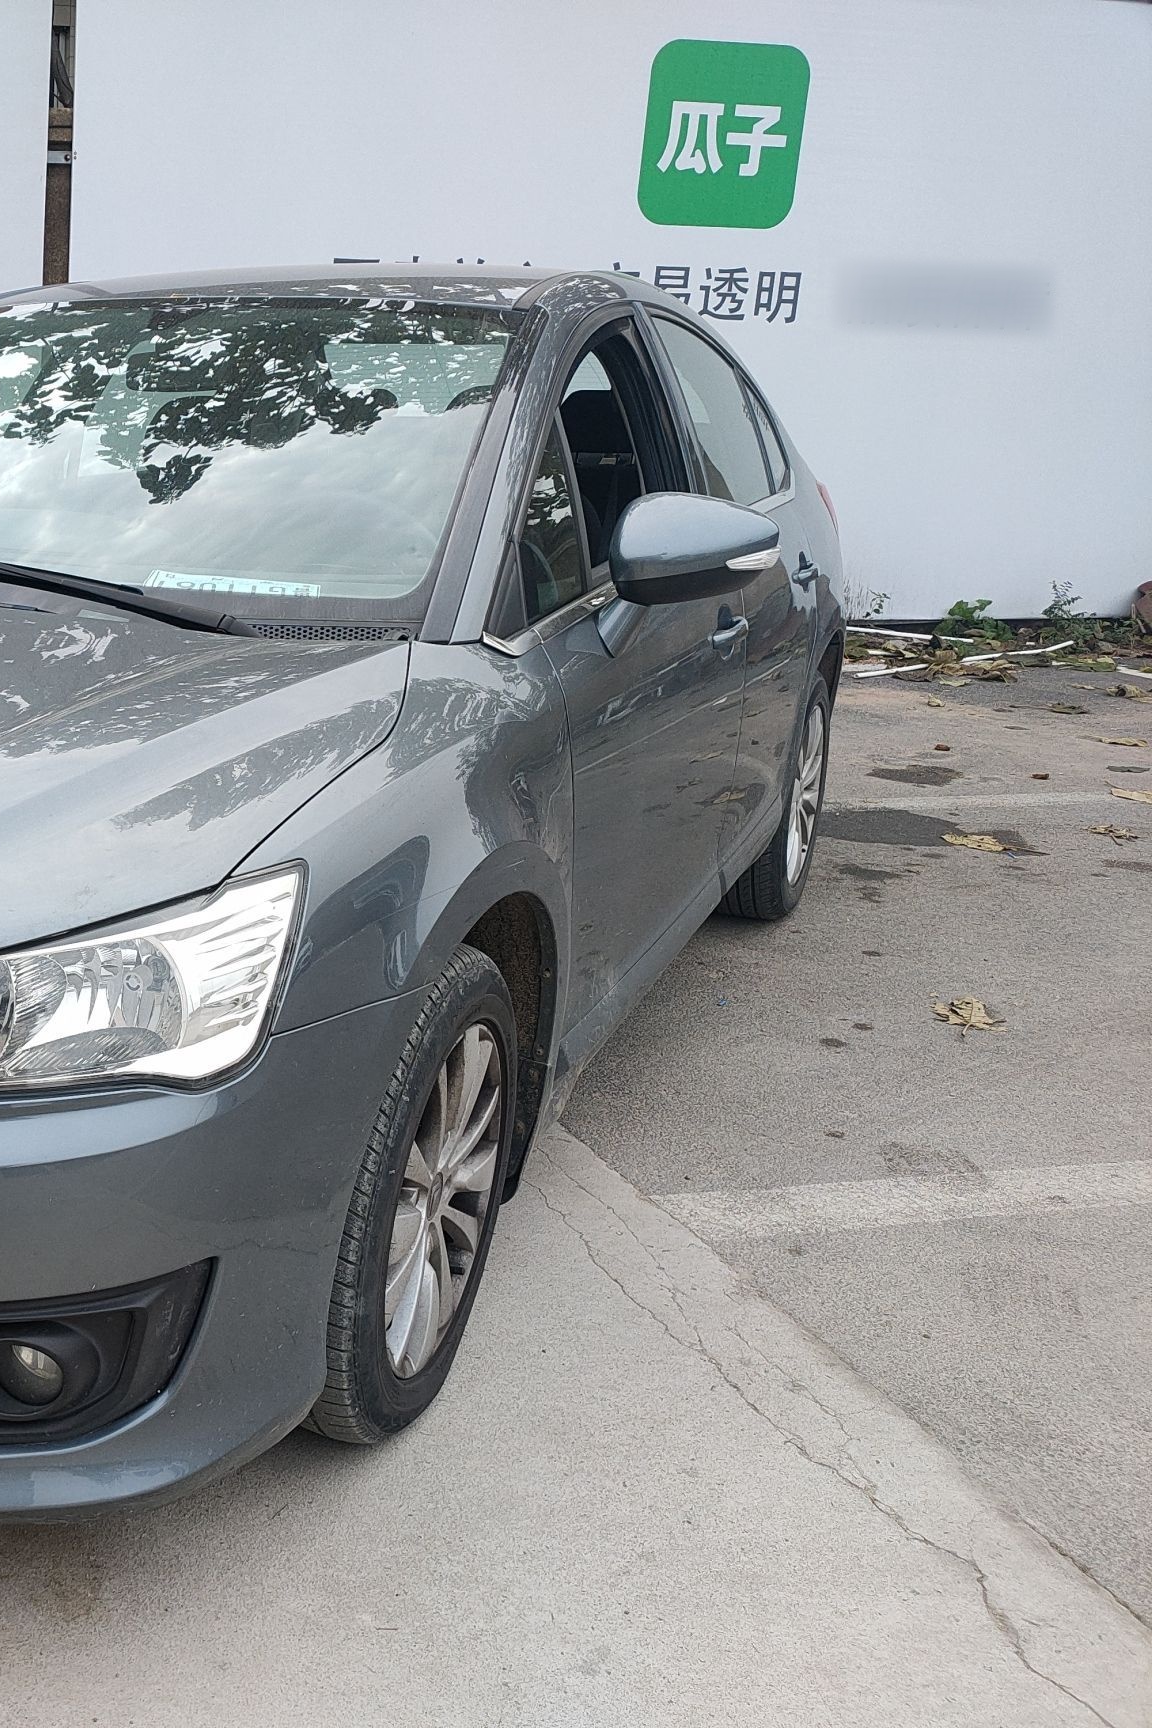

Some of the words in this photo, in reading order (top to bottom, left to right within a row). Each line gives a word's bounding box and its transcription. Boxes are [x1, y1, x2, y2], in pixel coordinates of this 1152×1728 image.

[656, 100, 787, 176] 瓜子
[613, 262, 802, 323] 易透明
